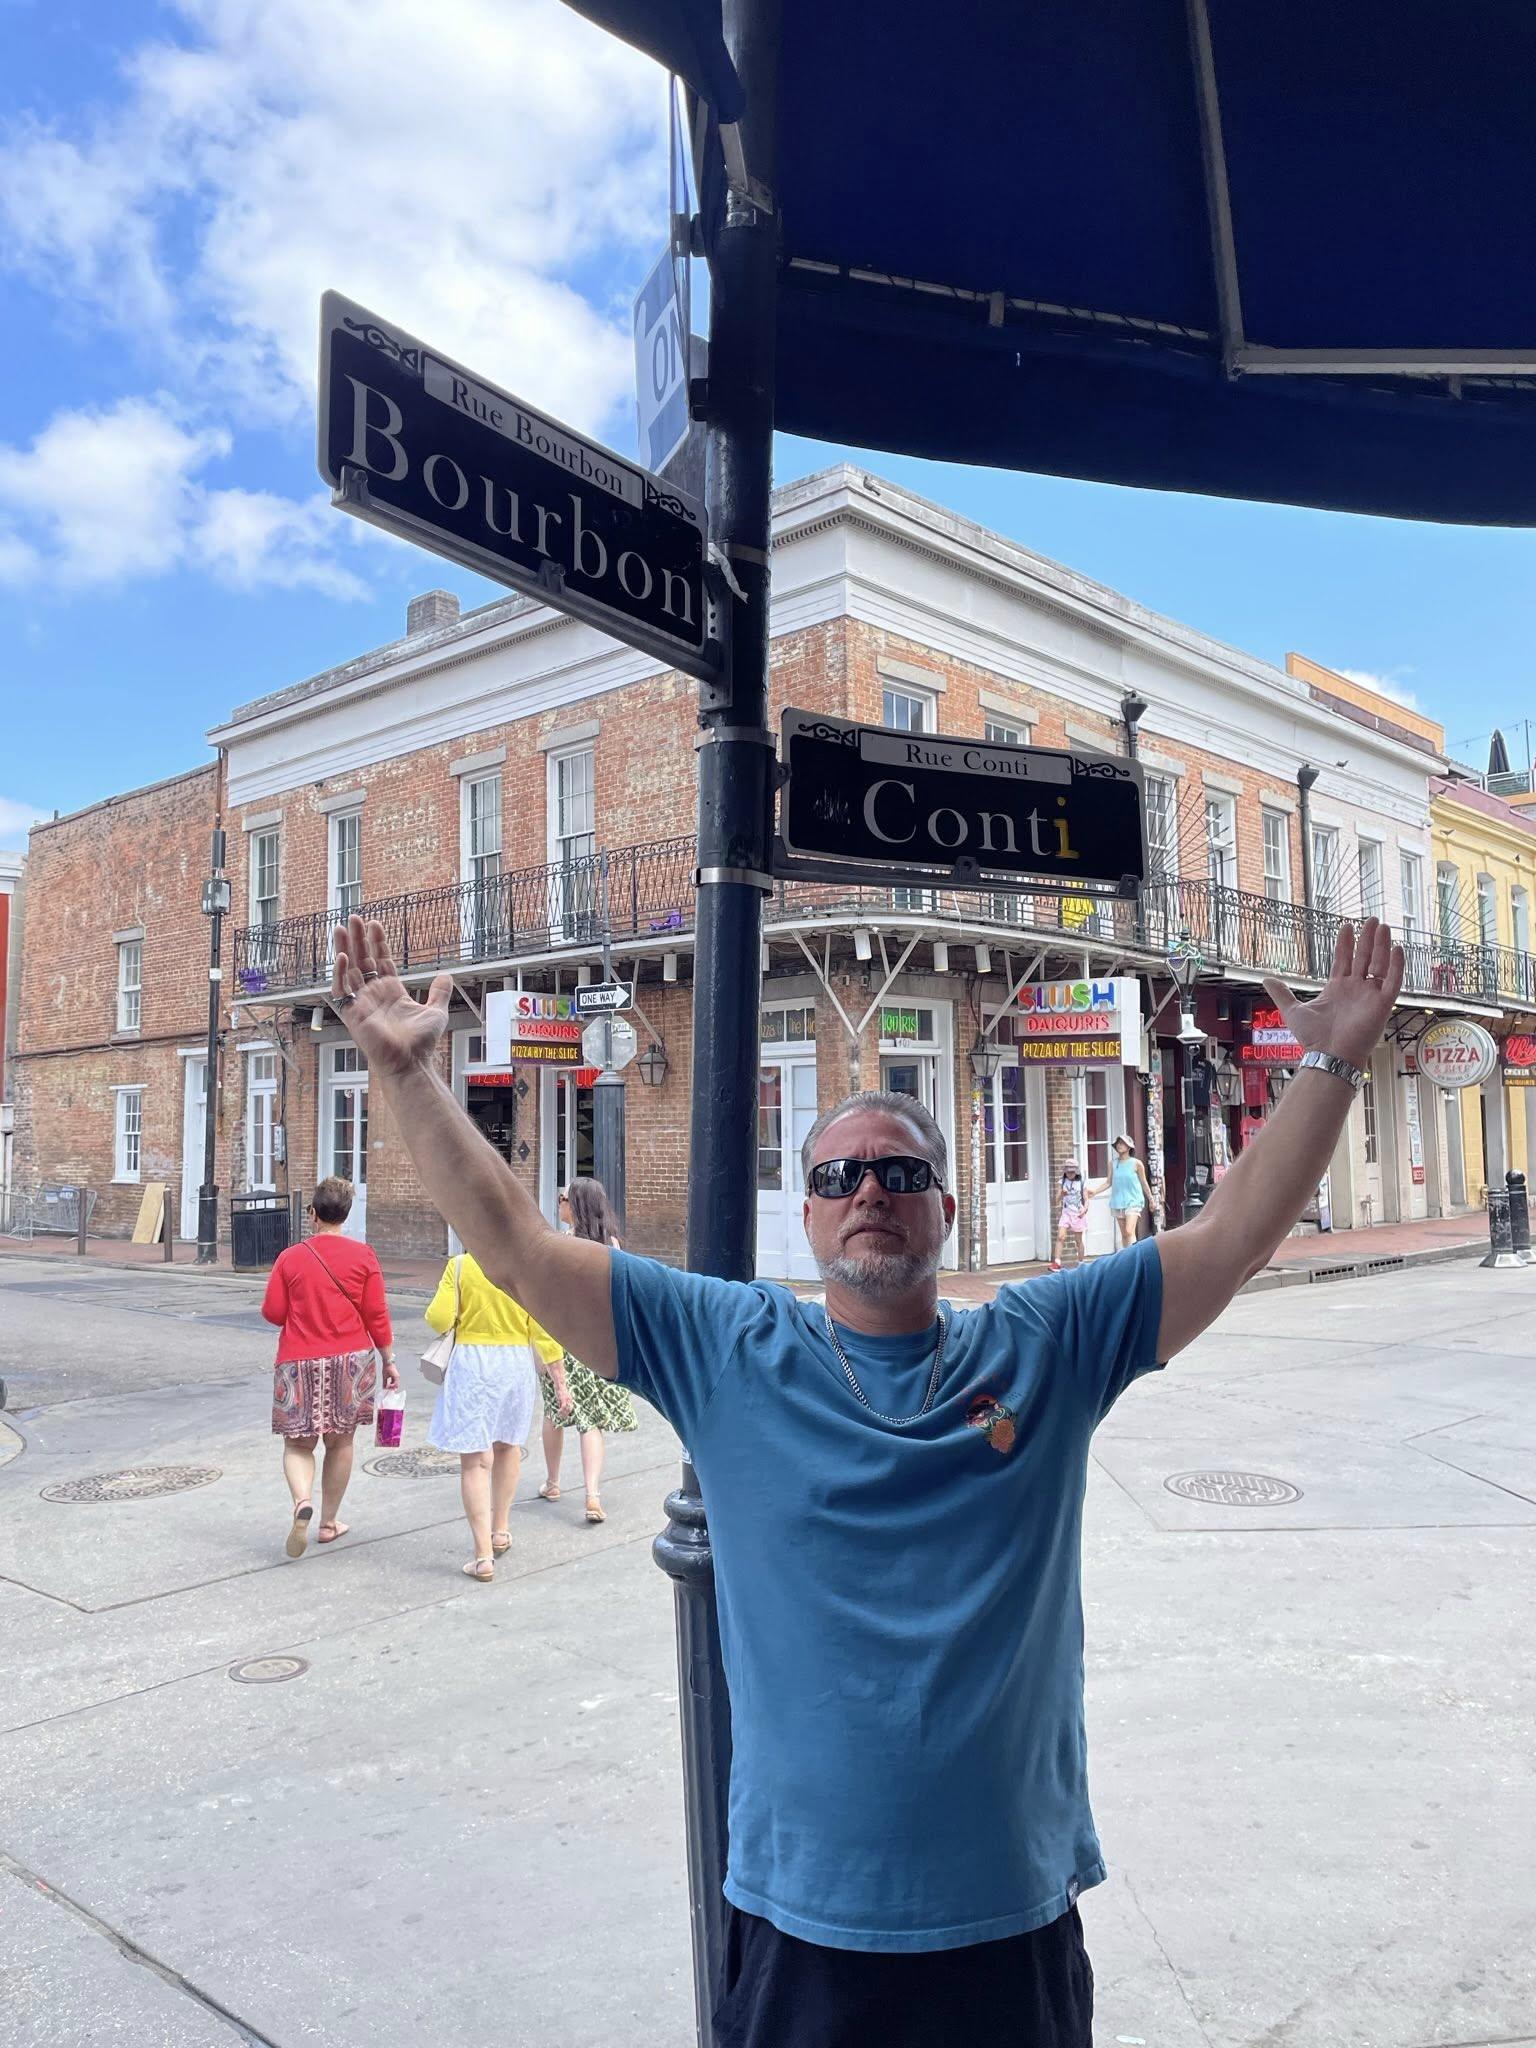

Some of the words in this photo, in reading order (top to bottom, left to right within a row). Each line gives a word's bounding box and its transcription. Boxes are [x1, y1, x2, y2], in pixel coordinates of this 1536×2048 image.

[450, 374, 504, 428] Rue
[515, 412, 624, 496] Bourbon
[343, 373, 696, 626] Bourbon
[905, 743, 953, 767] Rue
[963, 750, 1029, 776] Conti
[863, 778, 1081, 860] Conti
[582, 994, 597, 1005] ONE
[600, 992, 615, 1003] WAY
[1018, 982, 1116, 1015] SLUSH
[519, 1021, 580, 1039] DAIQUIRIS
[1027, 1014, 1110, 1033] DAIQUIRIS
[511, 1045, 532, 1058] PIZZA
[544, 1047, 557, 1059] THE
[558, 1047, 579, 1060] SLICE
[1023, 1041, 1051, 1058] PIZZA
[1052, 1041, 1068, 1058] BY
[1070, 1041, 1089, 1058] THE
[1091, 1040, 1121, 1057] SLICE
[1242, 1045, 1305, 1060] FUNER
[1424, 1047, 1480, 1063] PIZZA
